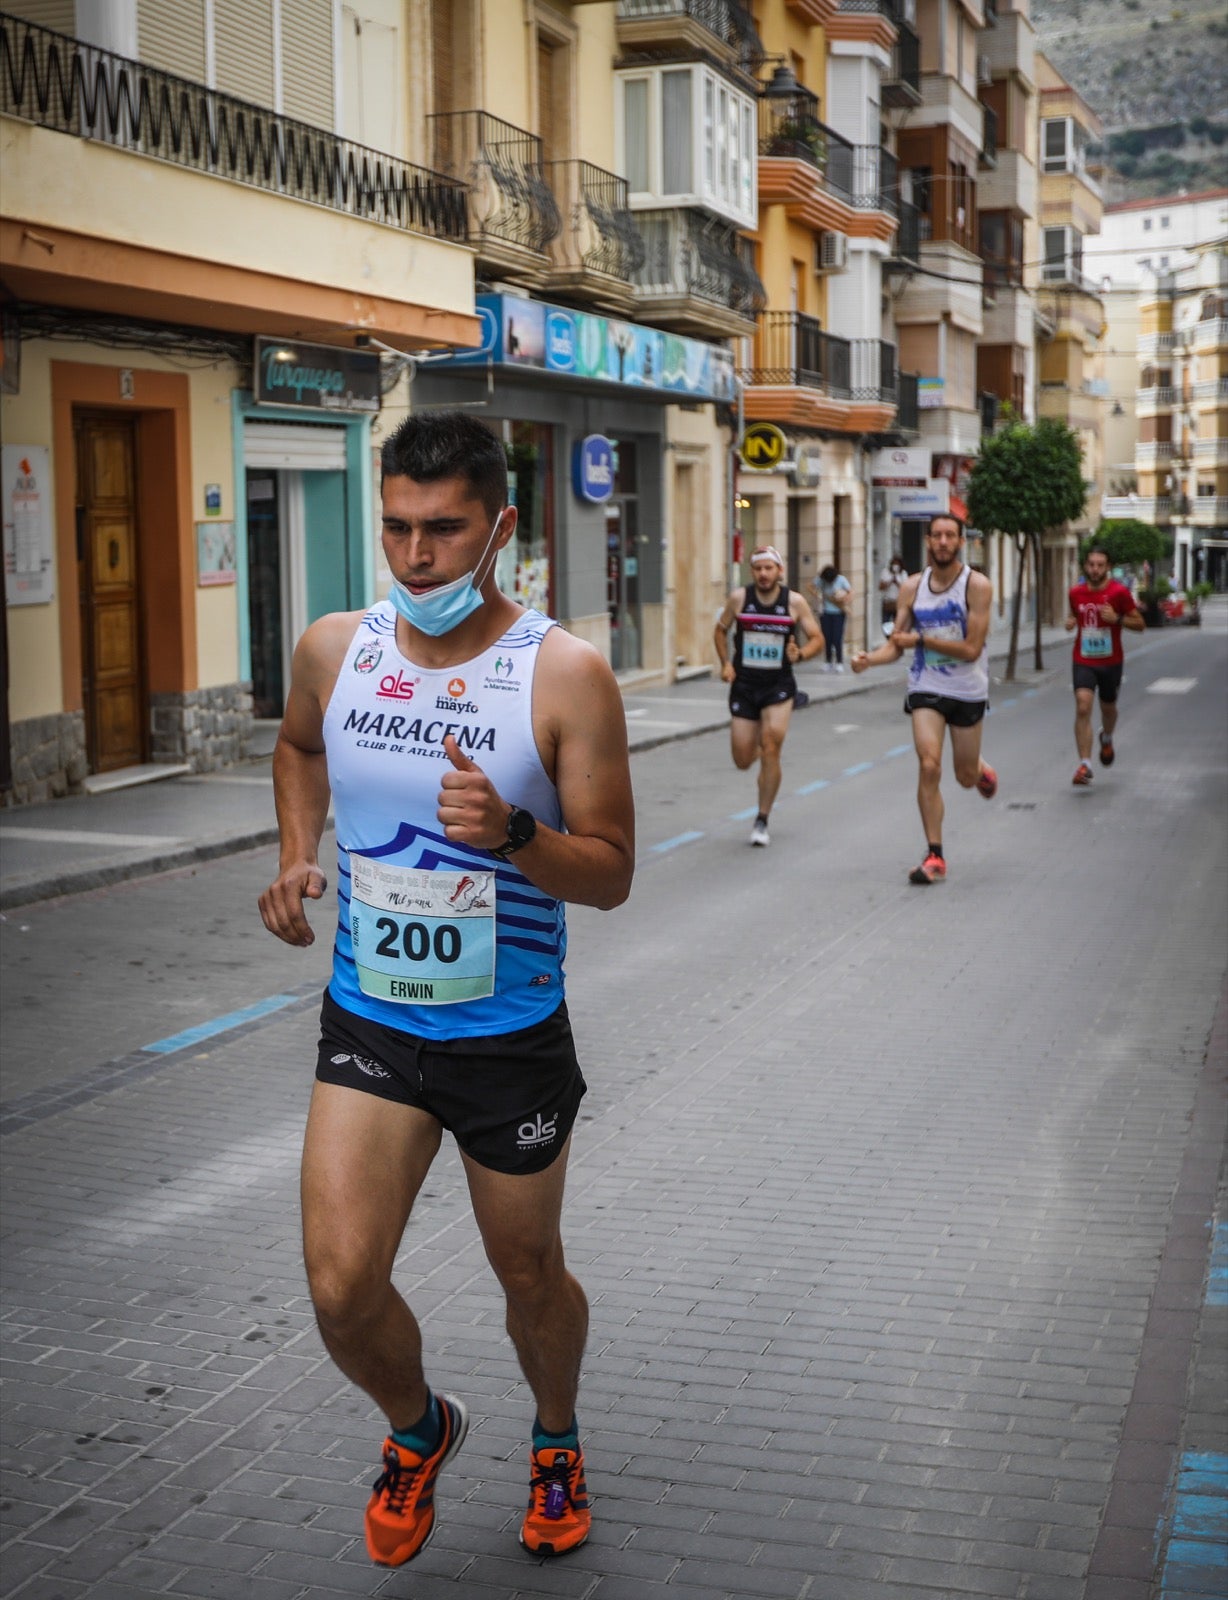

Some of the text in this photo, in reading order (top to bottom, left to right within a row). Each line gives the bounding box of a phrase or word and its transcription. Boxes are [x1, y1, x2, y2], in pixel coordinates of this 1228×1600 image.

[262, 345, 345, 402] Turquesa
[747, 436, 778, 457] IN
[748, 646, 778, 658] 1149
[376, 669, 414, 700] als
[485, 676, 521, 686] Ayuntamiento
[489, 683, 519, 692] Maracena
[435, 699, 479, 714] mayfo
[344, 709, 496, 751] MARACENA
[356, 739, 387, 750] CLUB
[390, 744, 406, 753] DE
[375, 917, 462, 964] 200
[390, 980, 434, 999] ERWIN
[516, 1113, 556, 1144] als
